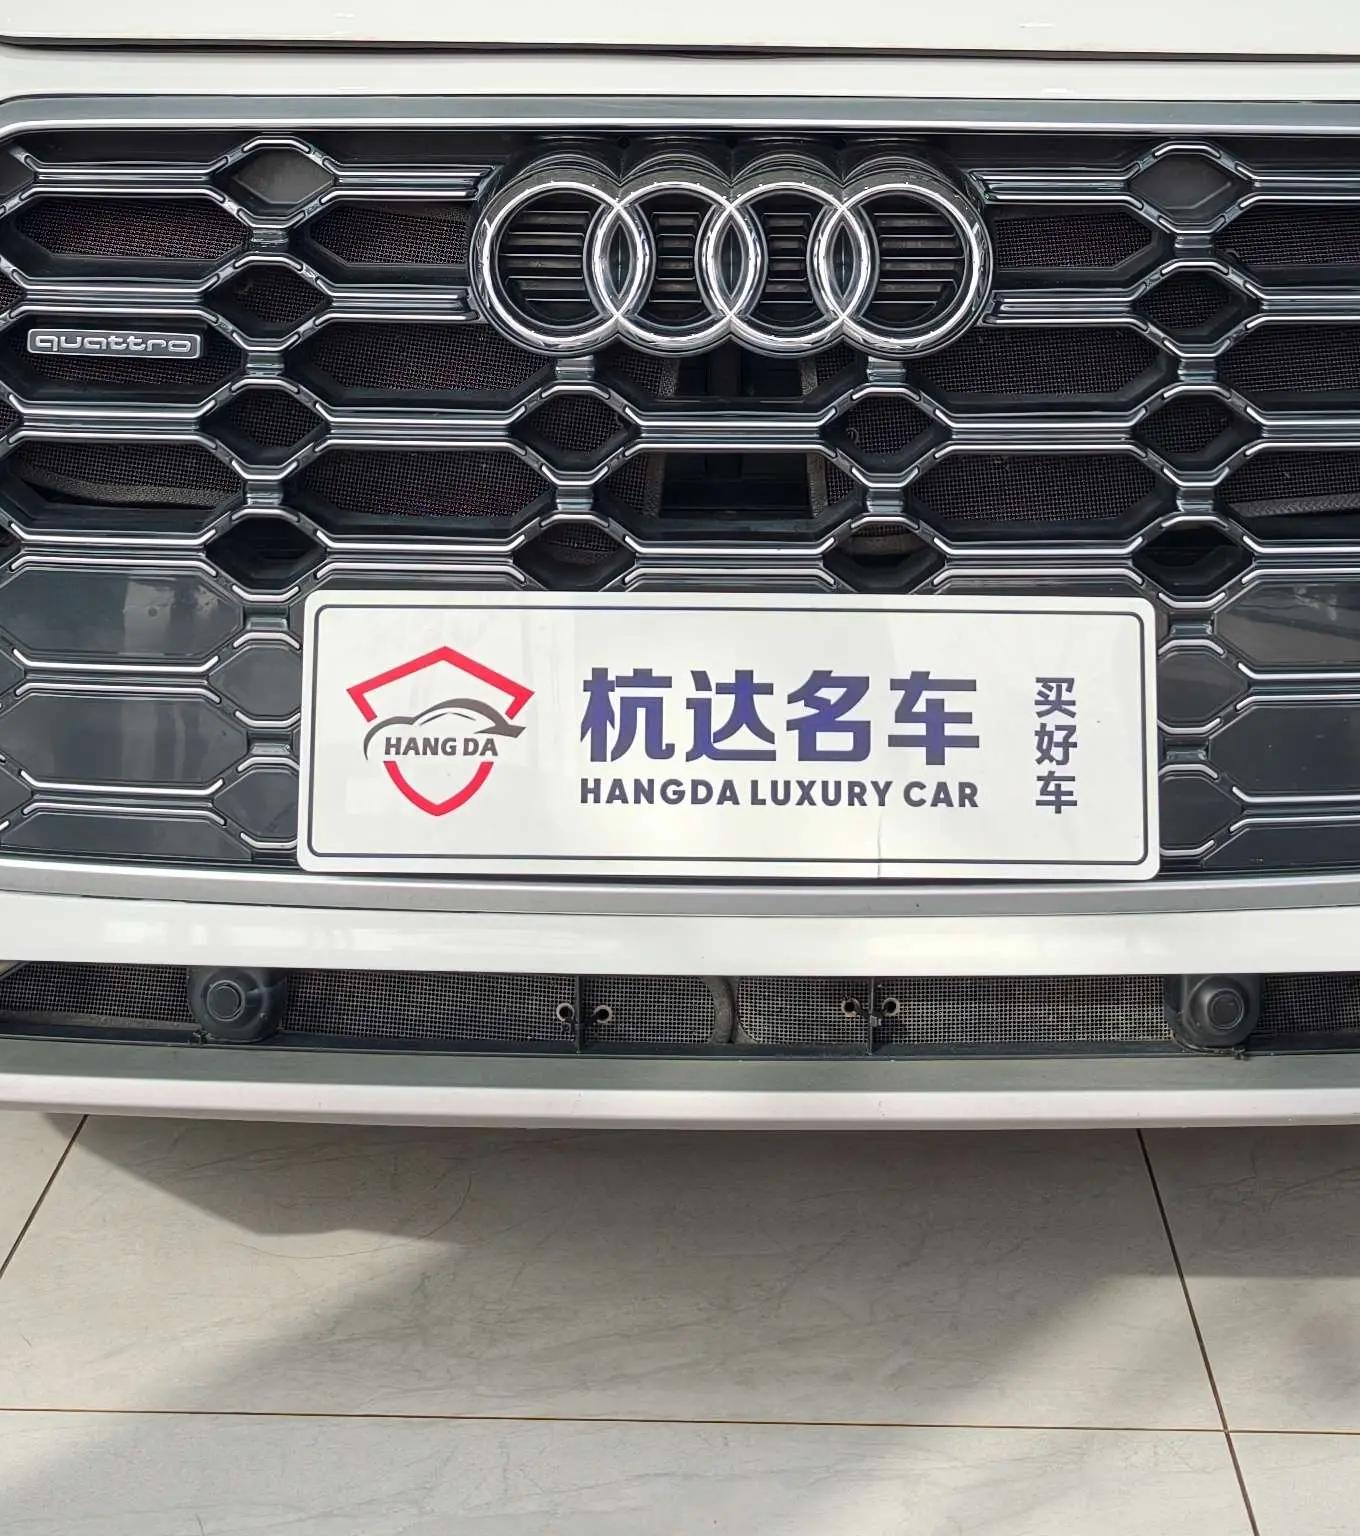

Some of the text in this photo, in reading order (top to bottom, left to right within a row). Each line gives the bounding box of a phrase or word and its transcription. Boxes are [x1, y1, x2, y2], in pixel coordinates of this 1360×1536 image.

[35, 335, 192, 353] quattro
[580, 667, 980, 766] 杭达名车
[383, 735, 500, 757] HANG DA
[1035, 676, 1078, 815] 买好车
[580, 777, 979, 808] HANGDA LUXURY CAR
